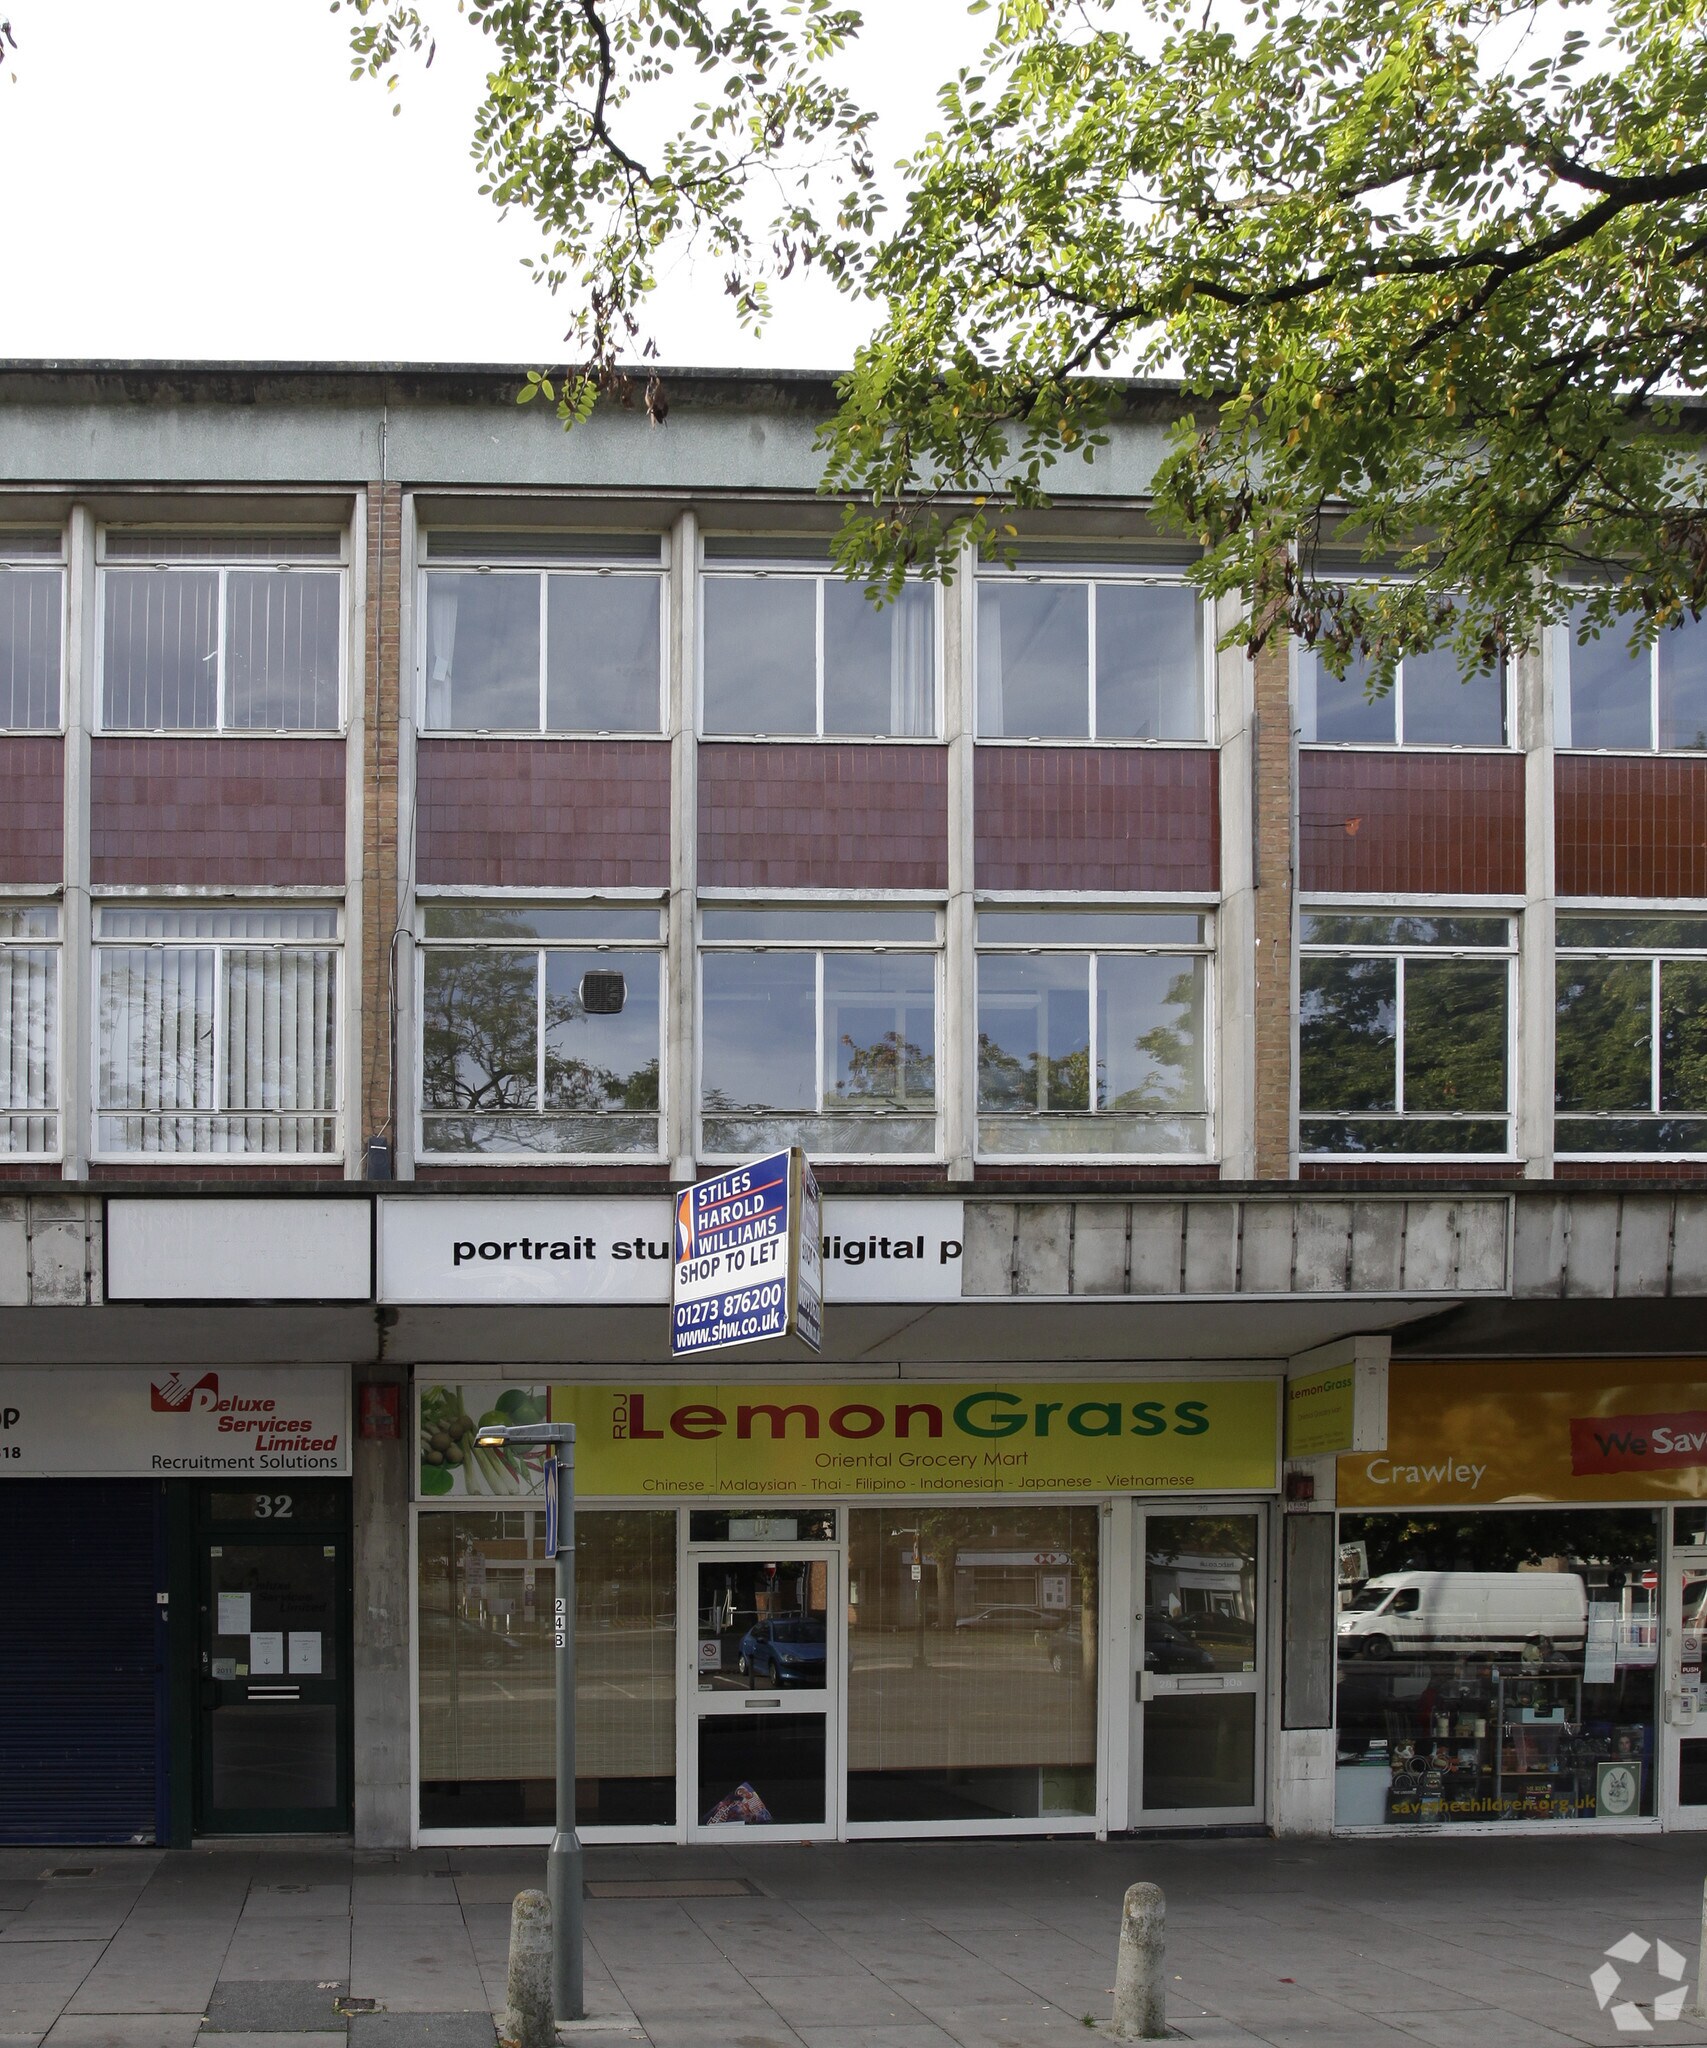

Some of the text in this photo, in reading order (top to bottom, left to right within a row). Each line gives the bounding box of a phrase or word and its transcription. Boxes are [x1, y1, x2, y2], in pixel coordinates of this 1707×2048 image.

[699, 1172, 751, 1206] STILES
[698, 1194, 765, 1231] HAROLD
[699, 1215, 777, 1255] WILLIAMS
[453, 1236, 597, 1266] portrait
[680, 1258, 720, 1285] SHOP
[726, 1249, 745, 1273] TO
[750, 1238, 779, 1267] LET
[677, 1299, 719, 1327] 01273
[723, 1283, 782, 1317] 876200
[676, 1307, 780, 1349] www.shw.co.uk
[189, 1387, 275, 1412] Deluxe
[0, 1408, 21, 1430] p
[218, 1415, 312, 1432] Services
[612, 1393, 628, 1440] RDJ
[0, 1446, 21, 1459] 18
[255, 1435, 338, 1451] Limited
[1594, 1427, 1707, 1457] We Sav
[152, 1454, 338, 1469] Recruitment Solutions
[815, 1450, 1029, 1469] Oriental Grocery Mart
[1366, 1456, 1488, 1490] Crawley
[642, 1479, 705, 1491] Chinese
[719, 1478, 797, 1493] Malaysian
[811, 1478, 842, 1490] Thai
[855, 1477, 906, 1492] Filipino
[920, 1476, 1004, 1489] Indonesian
[1018, 1476, 1092, 1491] Japanese
[1106, 1475, 1195, 1487] Vietnamese
[254, 1494, 293, 1519] 32
